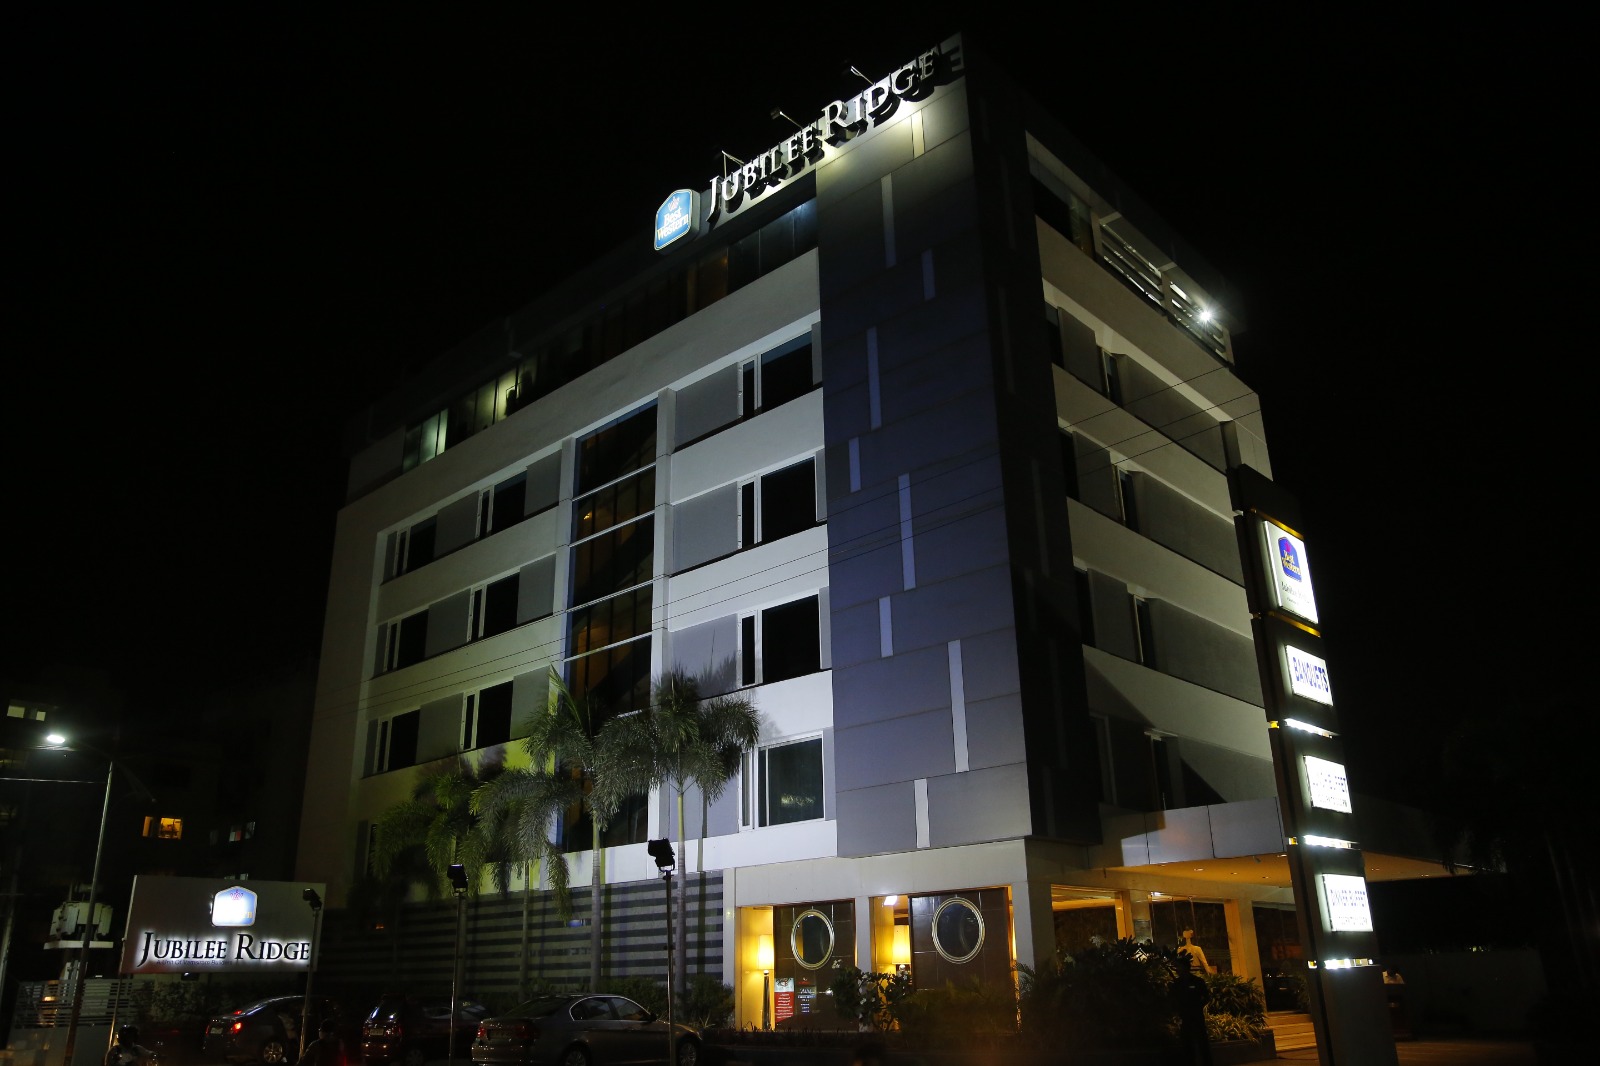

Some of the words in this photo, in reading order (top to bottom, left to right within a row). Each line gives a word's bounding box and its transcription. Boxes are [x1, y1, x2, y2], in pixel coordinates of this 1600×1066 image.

[706, 124, 817, 222] JUBILEE
[821, 47, 937, 138] RIDGE
[137, 932, 228, 967] JUBILEE
[235, 934, 310, 961] RIDGE
